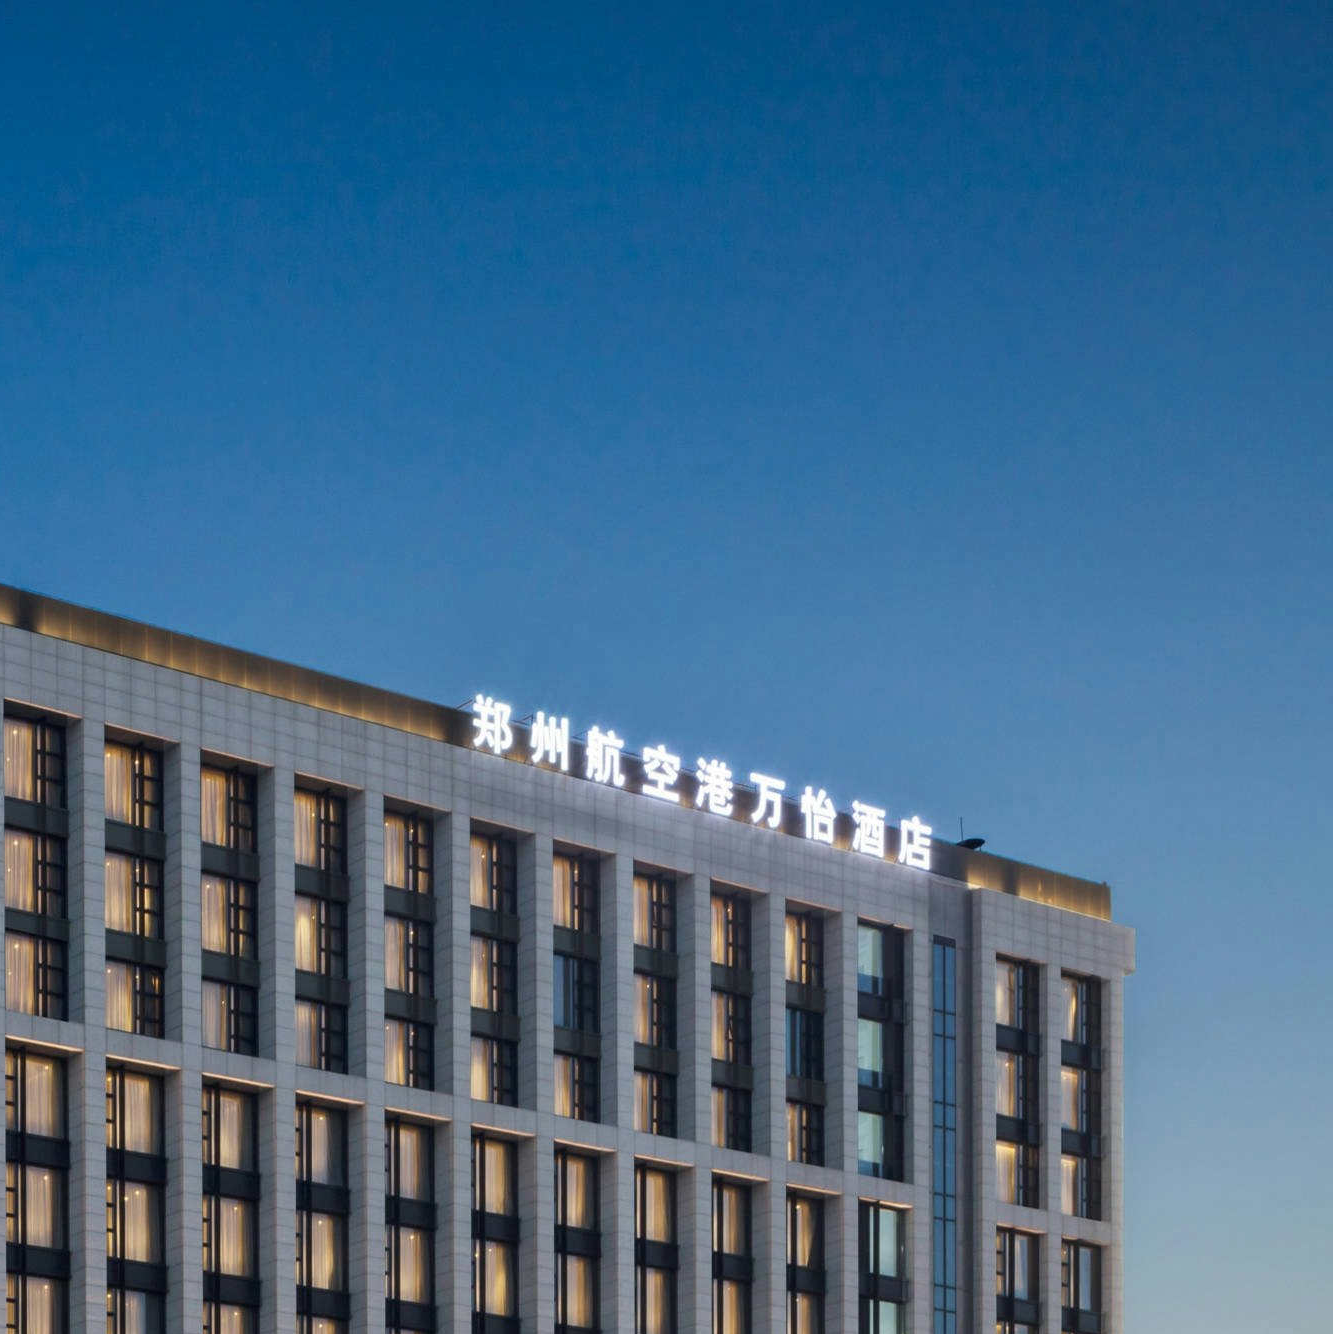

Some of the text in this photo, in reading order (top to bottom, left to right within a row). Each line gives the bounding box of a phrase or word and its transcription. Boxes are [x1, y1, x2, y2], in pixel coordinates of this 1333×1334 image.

[472, 694, 933, 872] 郑州航空港万怡酒店
